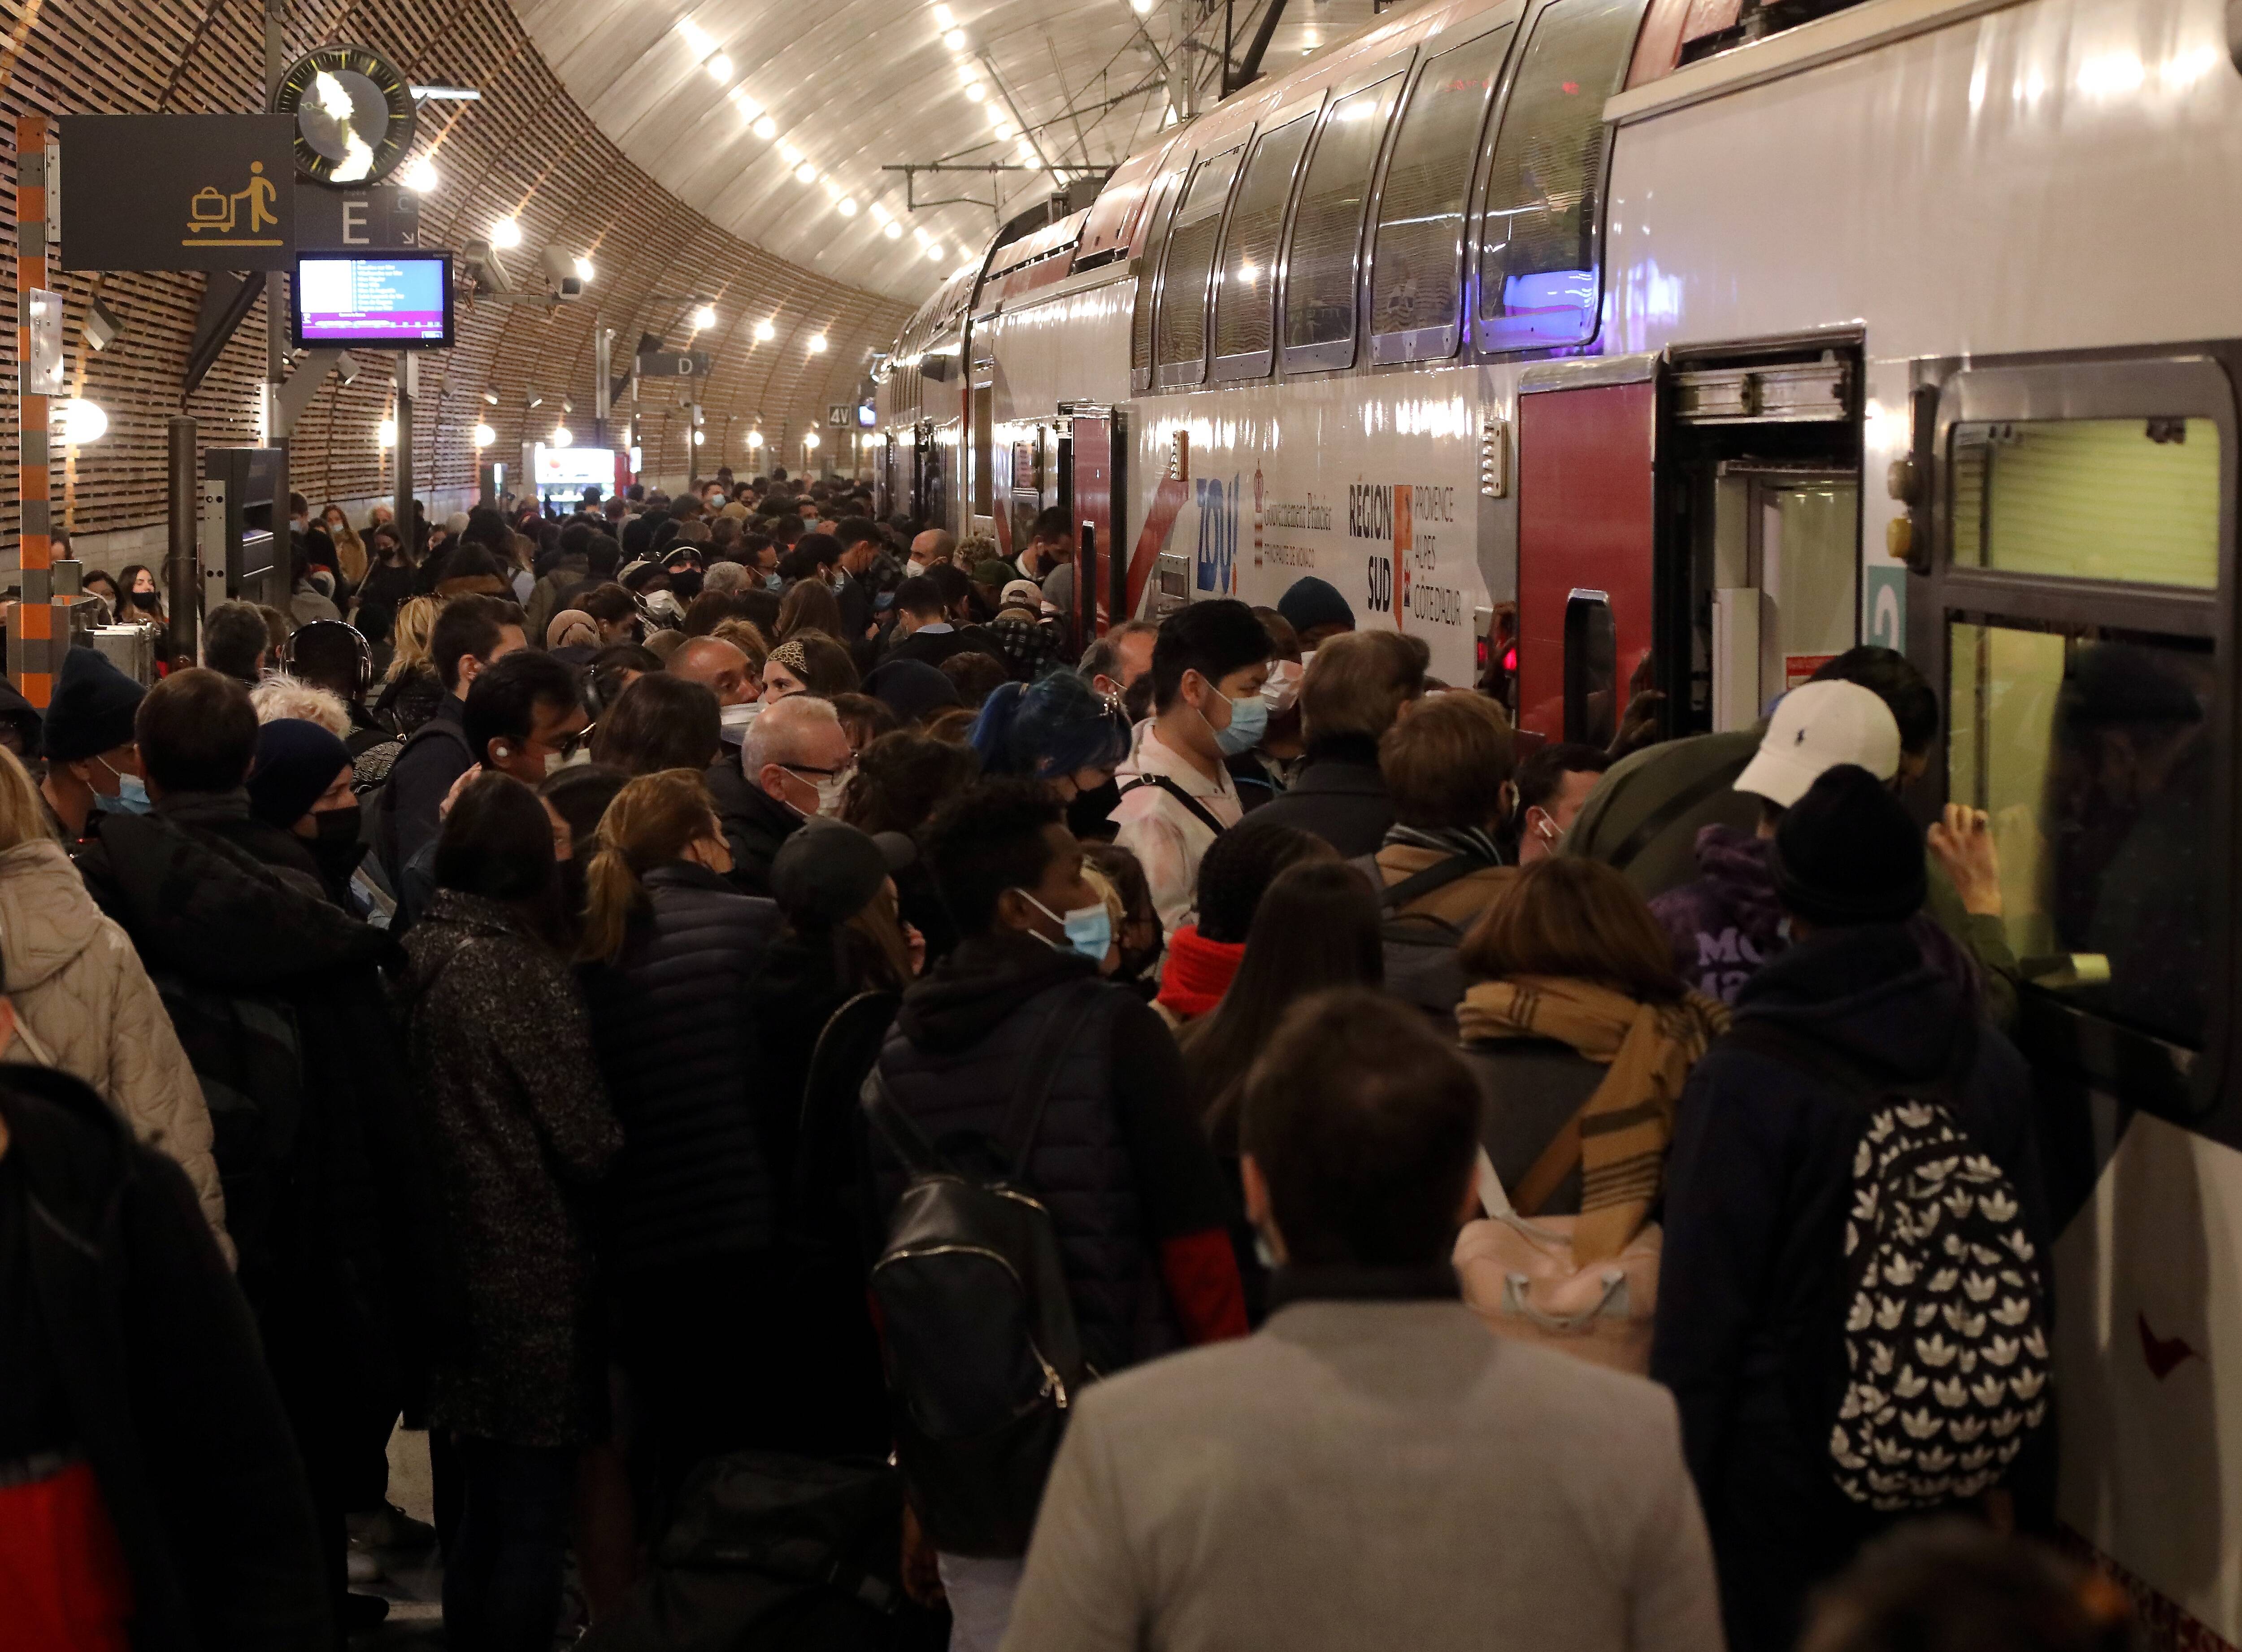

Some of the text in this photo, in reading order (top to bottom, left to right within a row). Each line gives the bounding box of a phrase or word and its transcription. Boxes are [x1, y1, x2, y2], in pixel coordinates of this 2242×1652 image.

[343, 201, 369, 244] E
[678, 357, 694, 375] D
[830, 407, 849, 424] 4V
[1349, 474, 1392, 540] RÉGION
[1415, 485, 1454, 522] PROVENCE
[1414, 534, 1436, 570] ALPES
[1368, 555, 1391, 613] SUD
